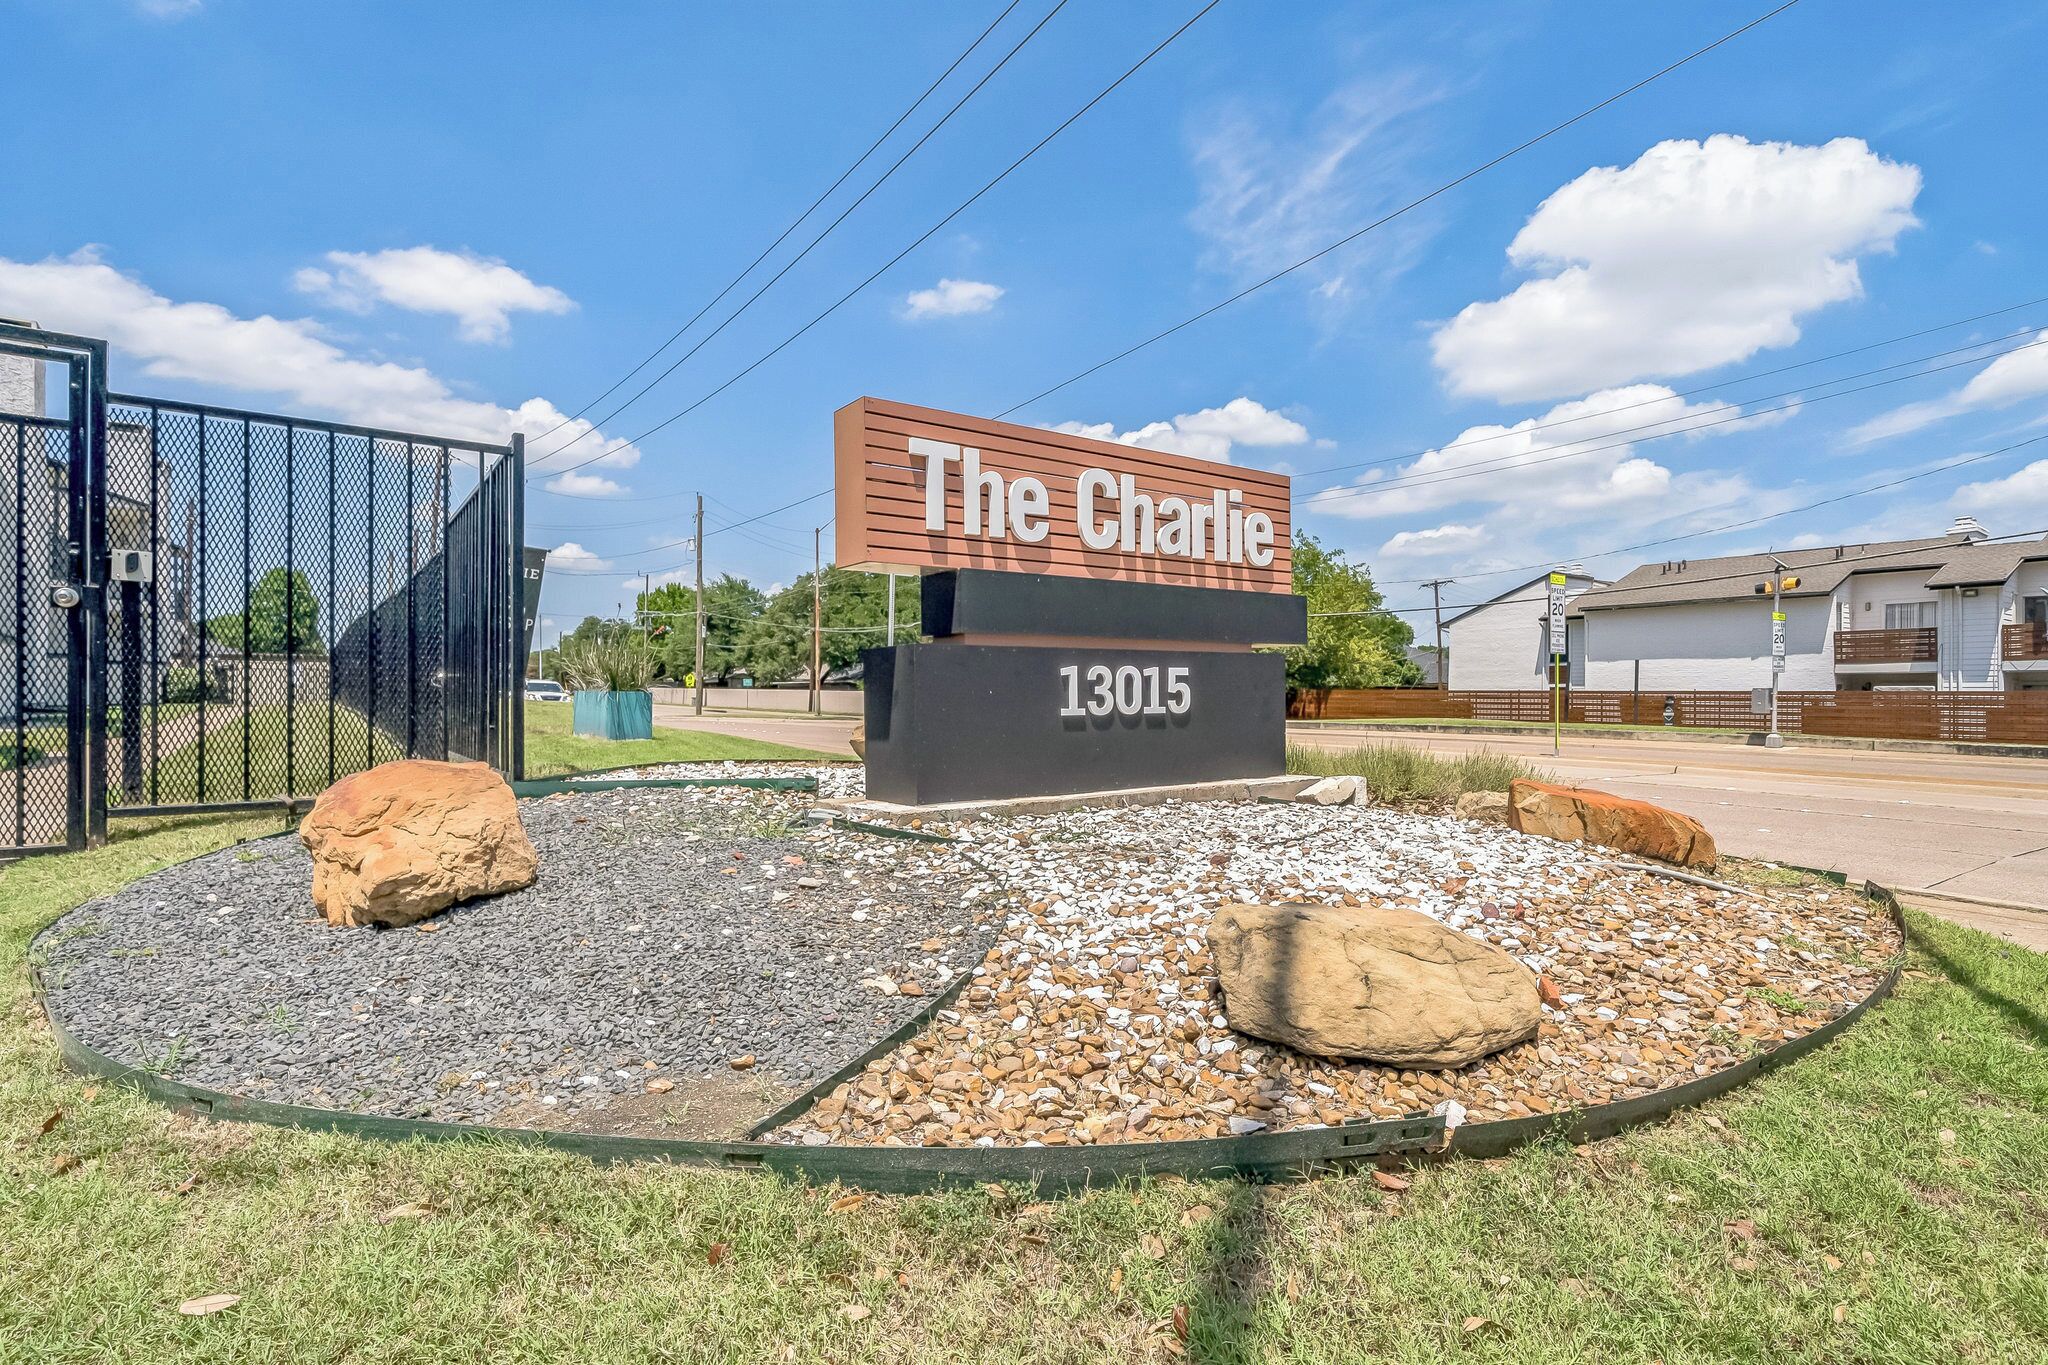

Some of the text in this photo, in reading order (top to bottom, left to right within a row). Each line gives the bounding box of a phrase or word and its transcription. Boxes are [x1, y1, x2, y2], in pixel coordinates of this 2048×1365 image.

[908, 437, 1275, 567] The Charlie
[1551, 587, 1566, 595] SPEED
[1552, 603, 1564, 616] 20
[1773, 634, 1785, 644] 20
[1060, 665, 1191, 716] 13015
